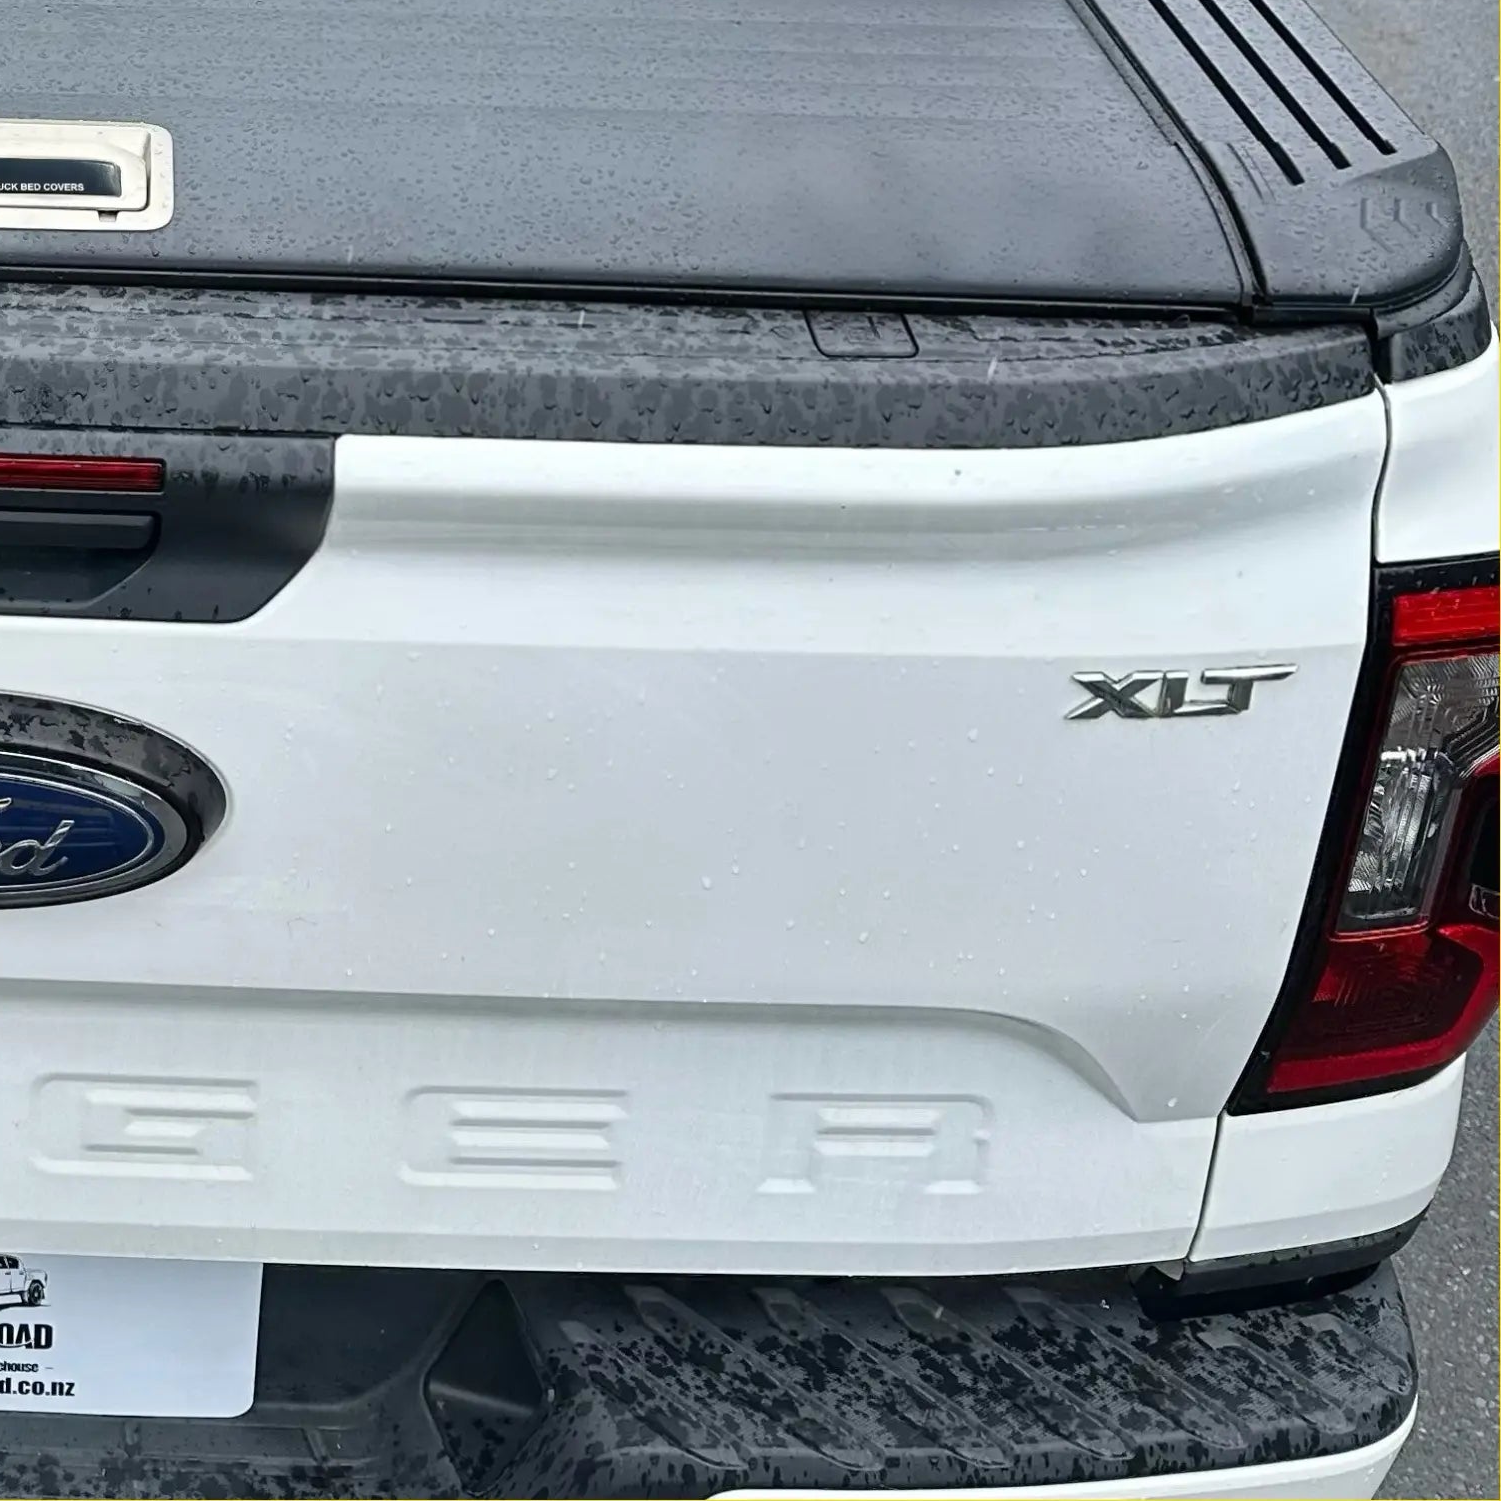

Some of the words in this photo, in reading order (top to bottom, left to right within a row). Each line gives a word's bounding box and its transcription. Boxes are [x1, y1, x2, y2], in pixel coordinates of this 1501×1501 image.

[20, 183, 40, 192] BED
[43, 183, 84, 192] COVERS
[1063, 662, 1298, 720] XLT
